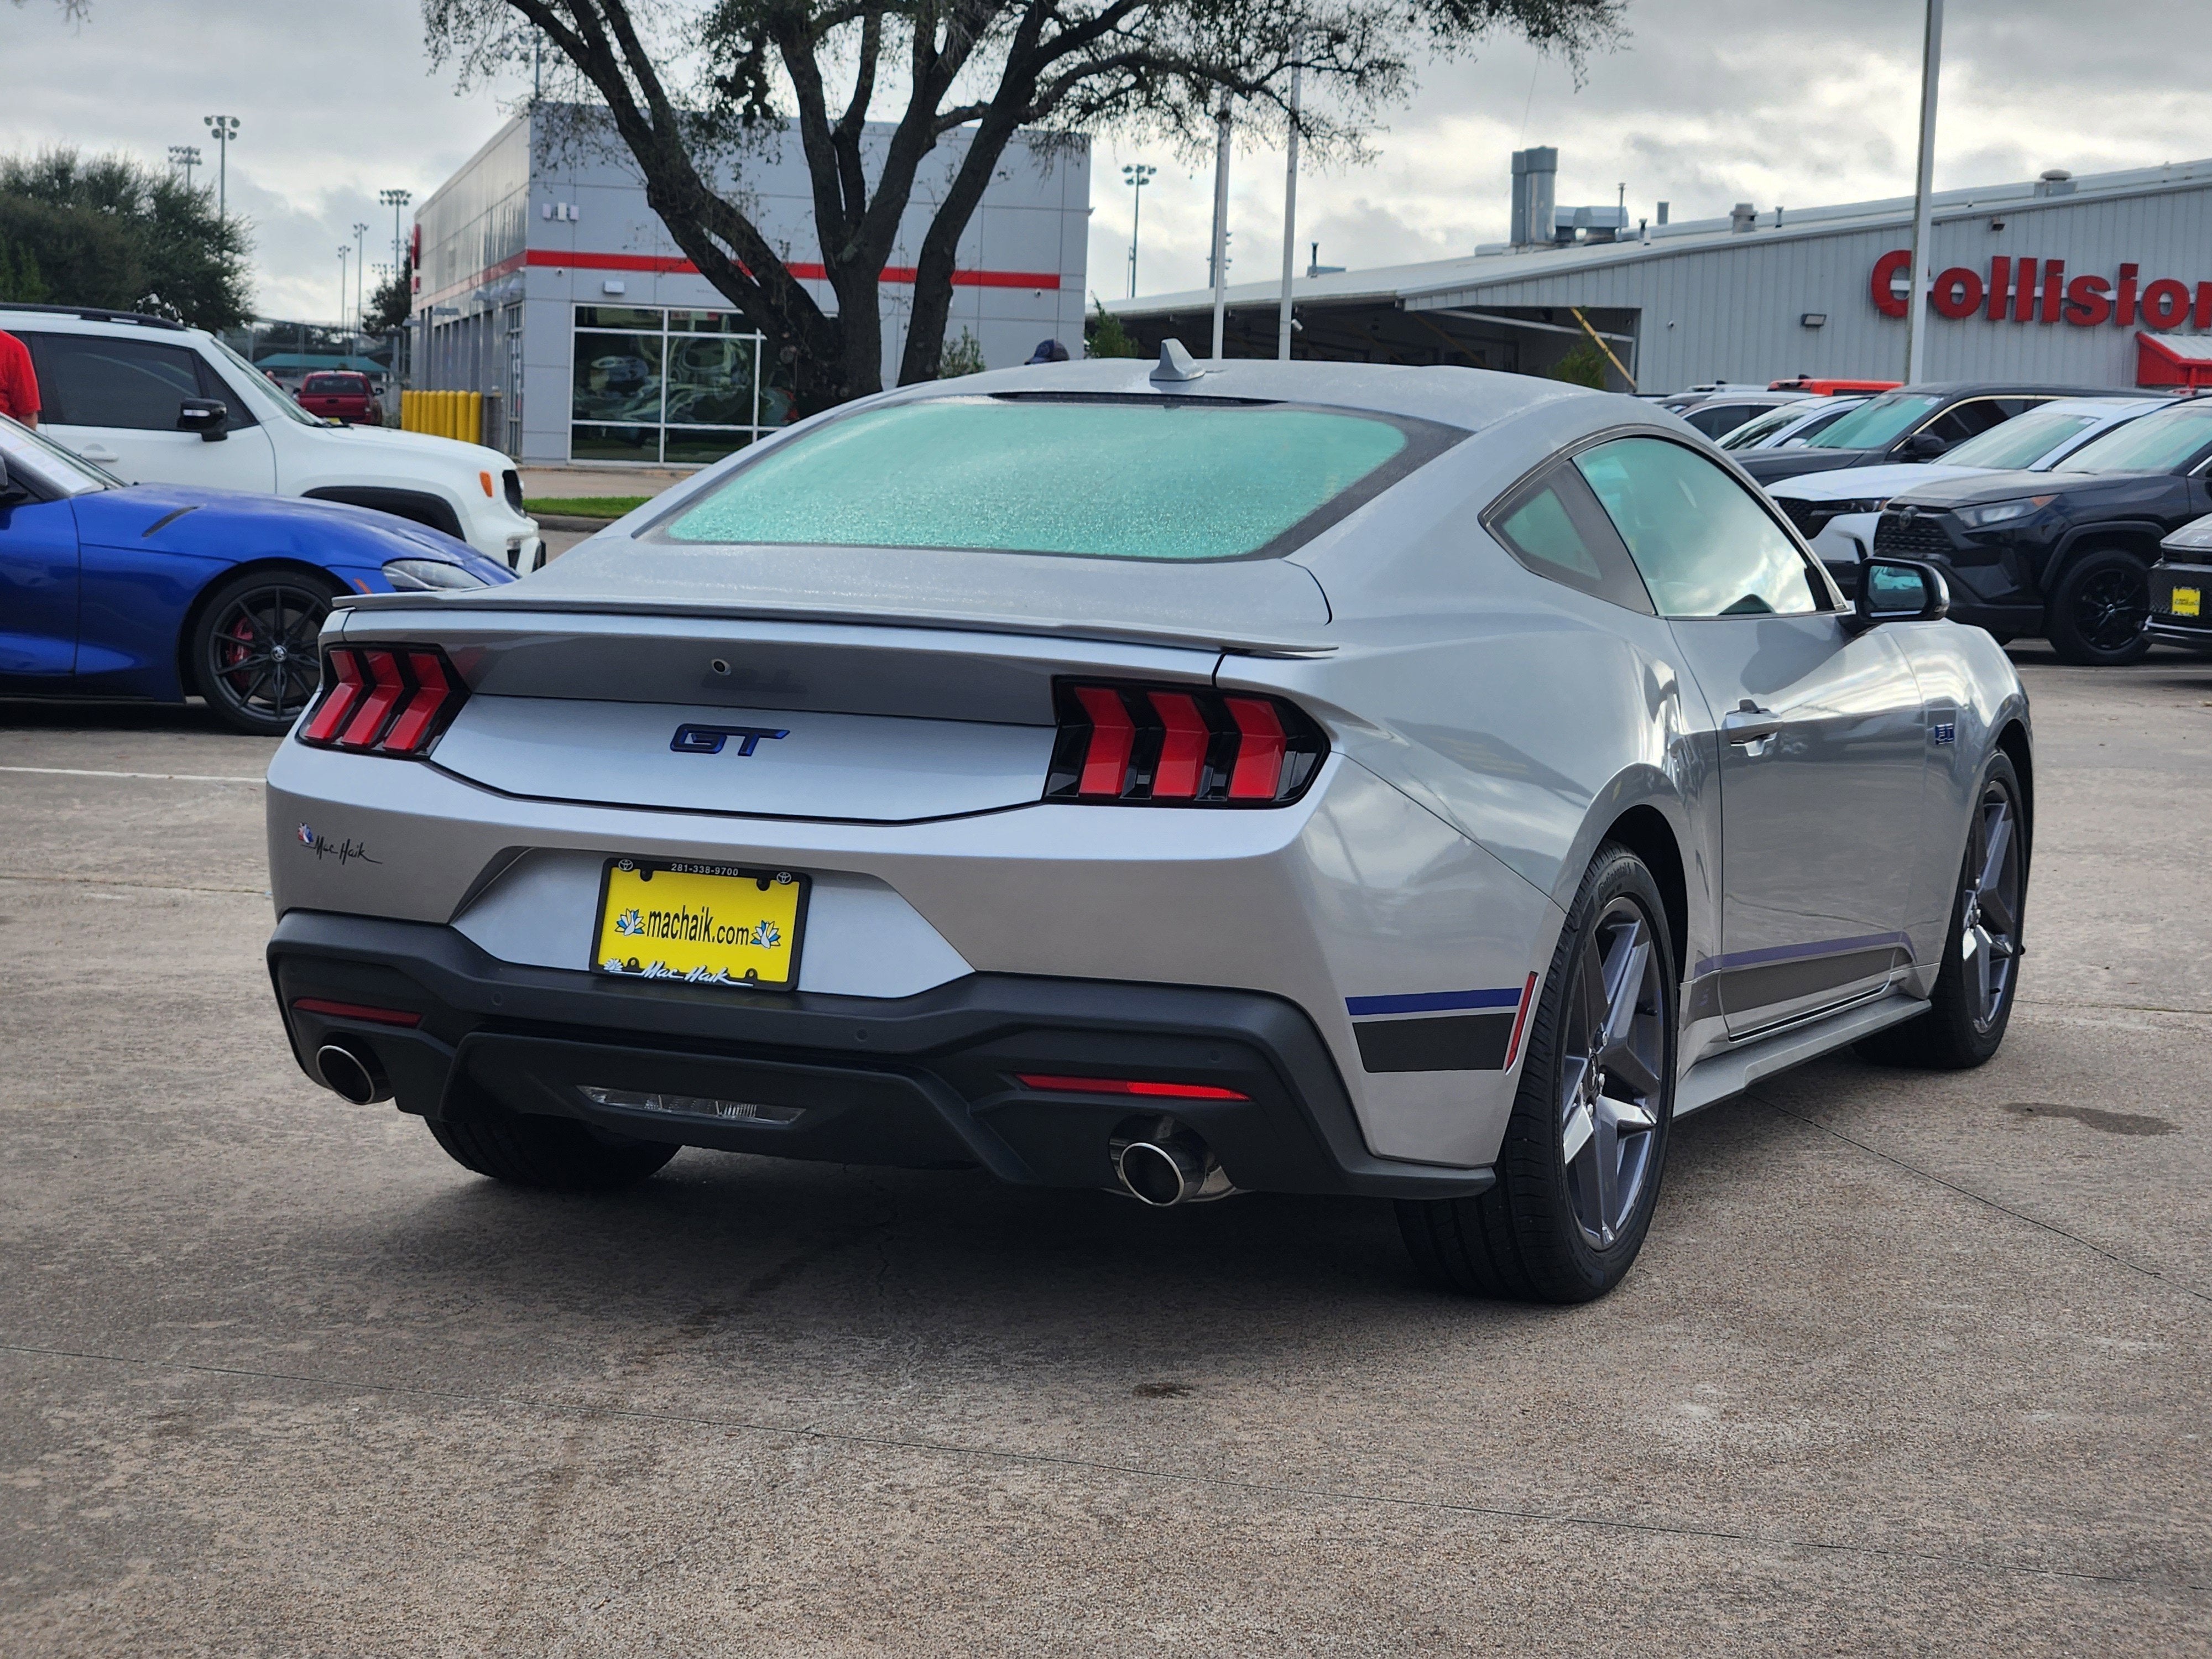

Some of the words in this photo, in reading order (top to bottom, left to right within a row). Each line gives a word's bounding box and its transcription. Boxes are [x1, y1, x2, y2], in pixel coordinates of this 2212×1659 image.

[670, 723, 790, 757] GT
[671, 863, 739, 877] 281-338-9700
[646, 905, 749, 946] machaik.com
[639, 961, 684, 979] Mac
[684, 965, 741, 985] Haik
